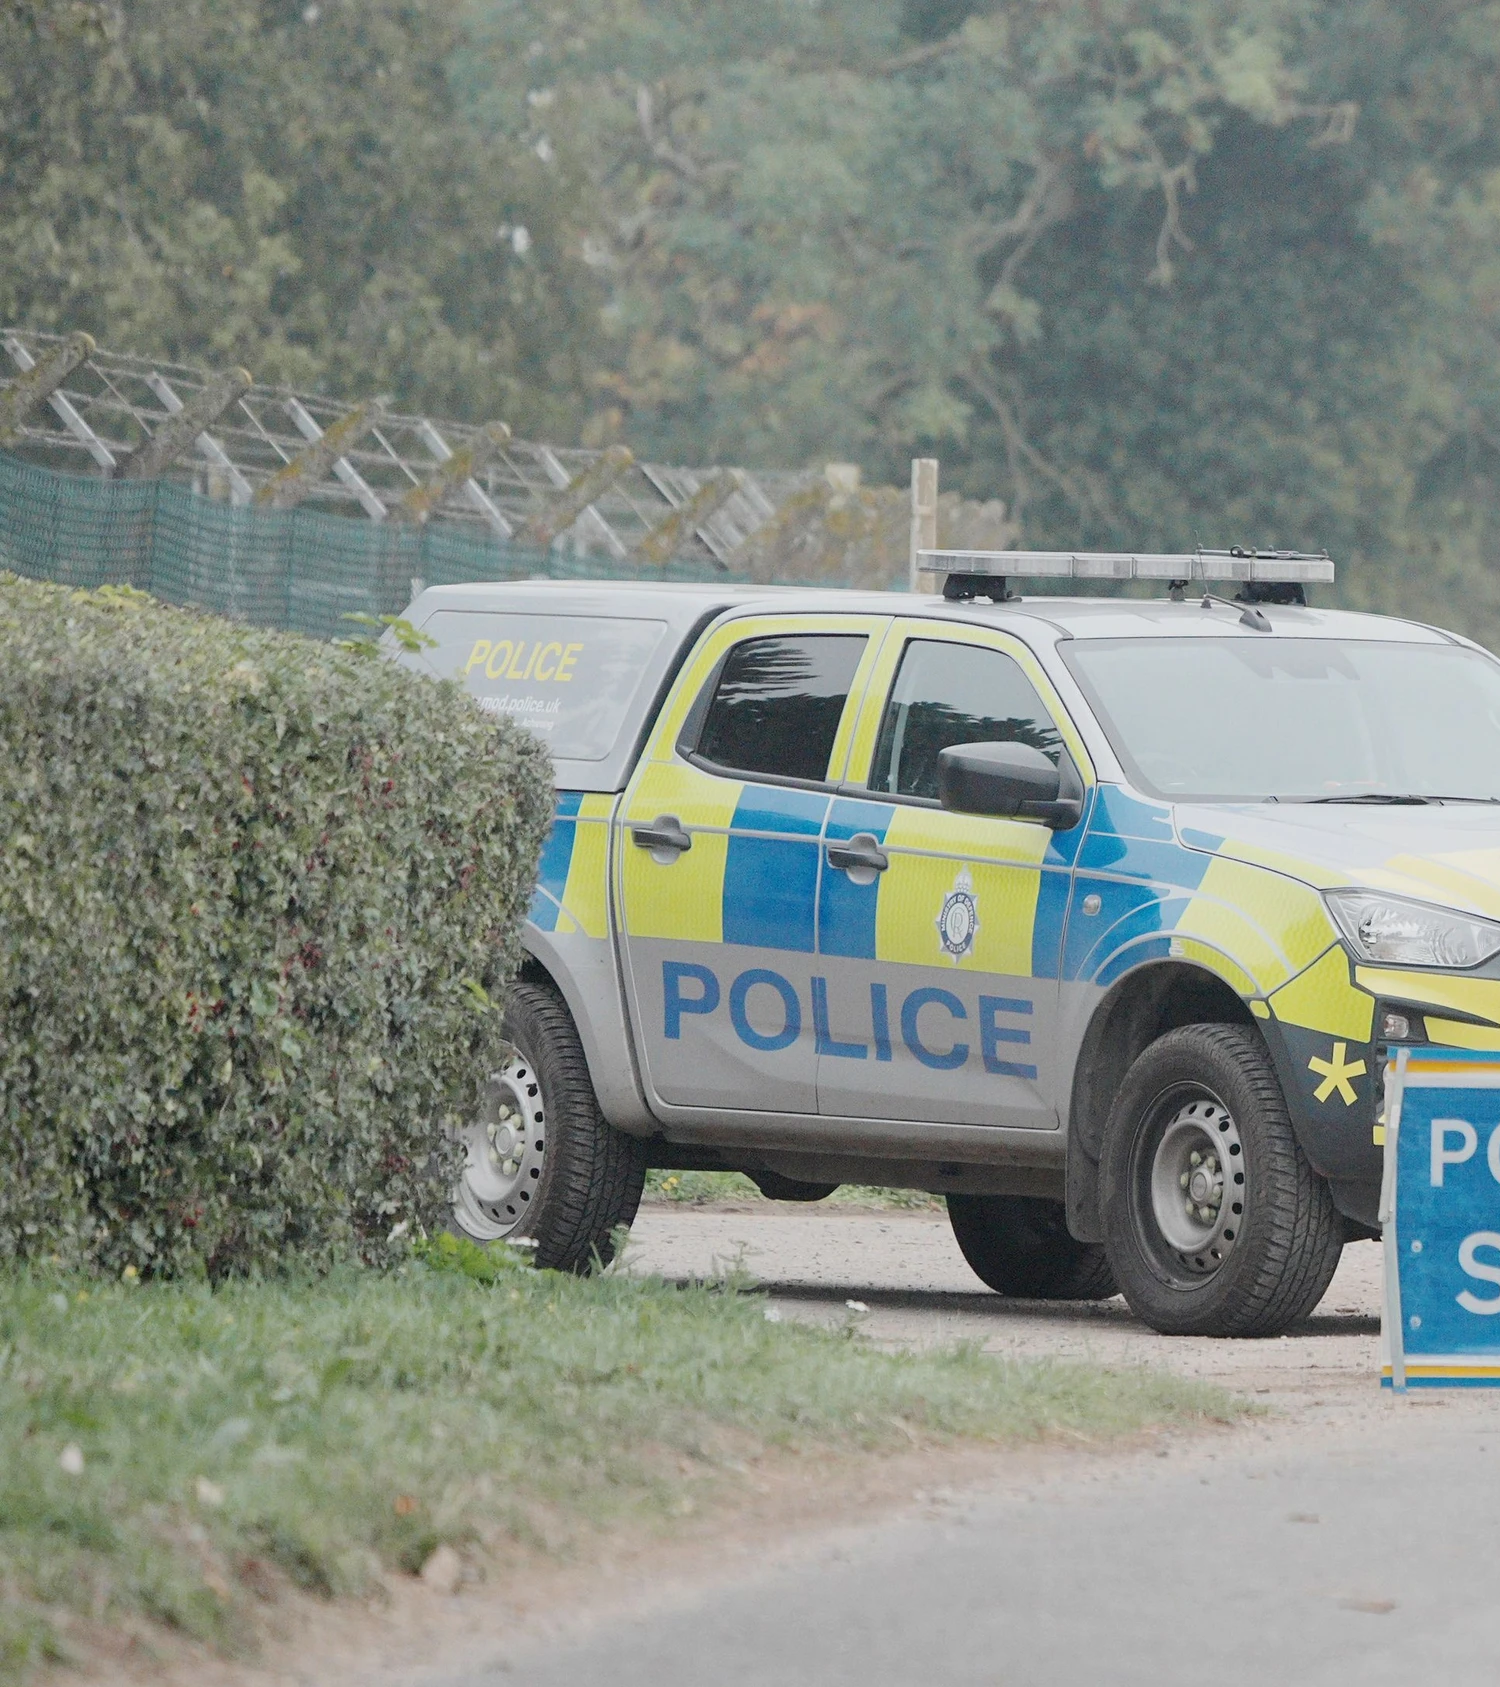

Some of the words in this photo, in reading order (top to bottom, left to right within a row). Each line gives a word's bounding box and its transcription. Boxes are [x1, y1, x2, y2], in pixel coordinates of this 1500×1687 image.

[464, 639, 584, 682] POLICE
[945, 940, 966, 953] POLICE
[661, 960, 1038, 1080] POLICE
